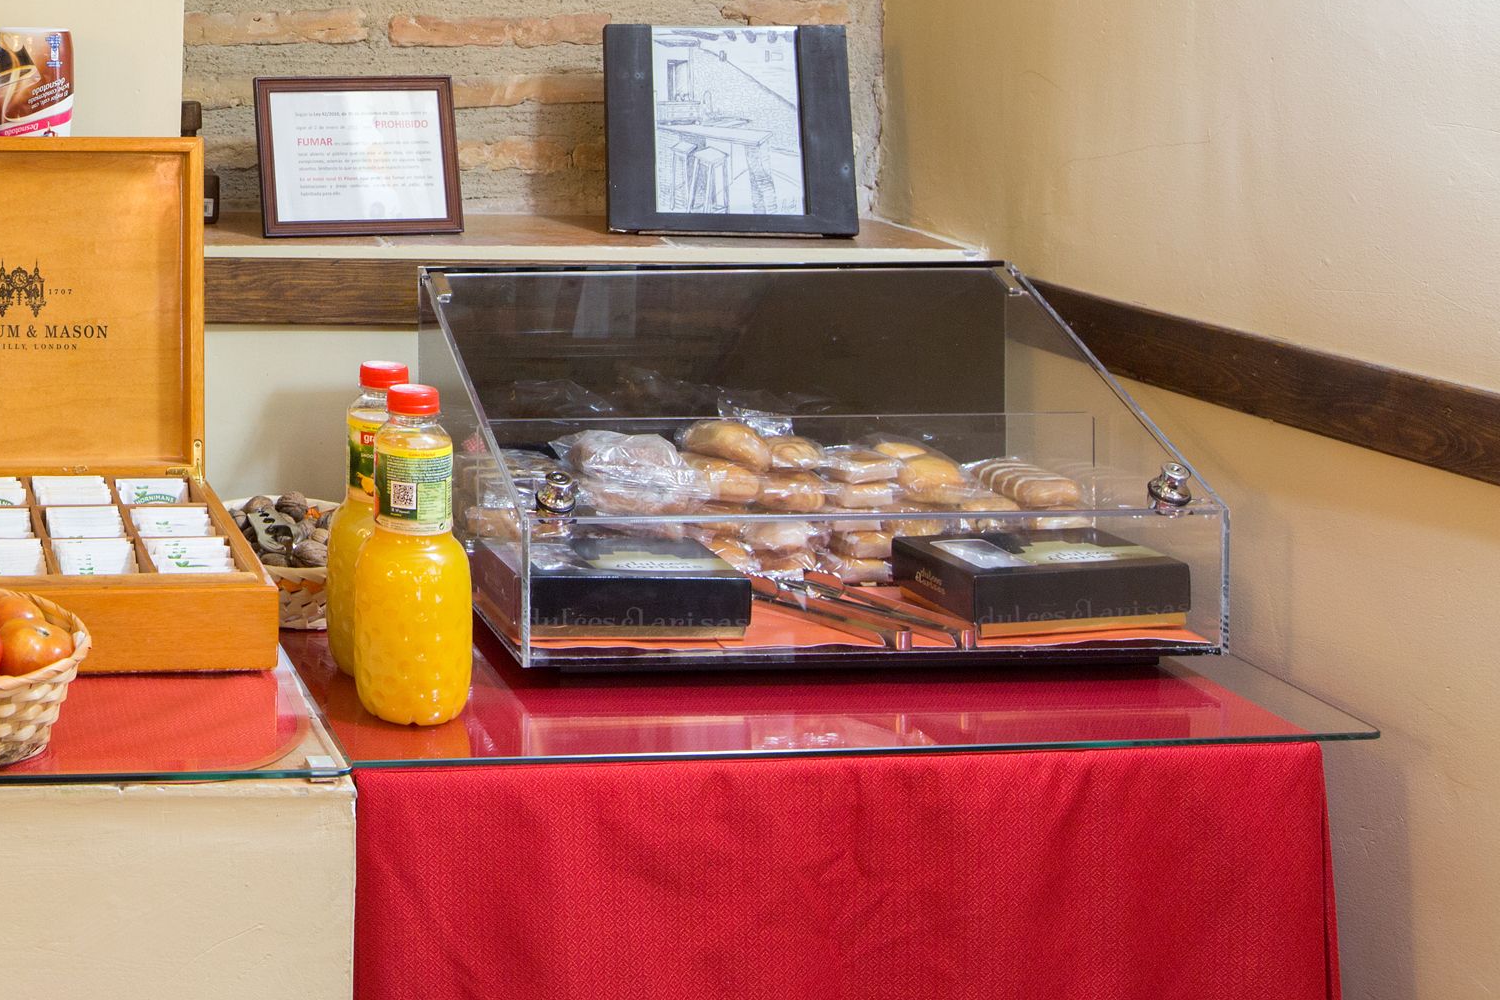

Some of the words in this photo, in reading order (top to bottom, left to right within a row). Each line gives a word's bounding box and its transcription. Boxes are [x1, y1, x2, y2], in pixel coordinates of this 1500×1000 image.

[375, 119, 428, 128] PROHIBIDO
[297, 137, 333, 146] FUMAR
[26, 325, 38, 338] &
[45, 325, 109, 339] MASON
